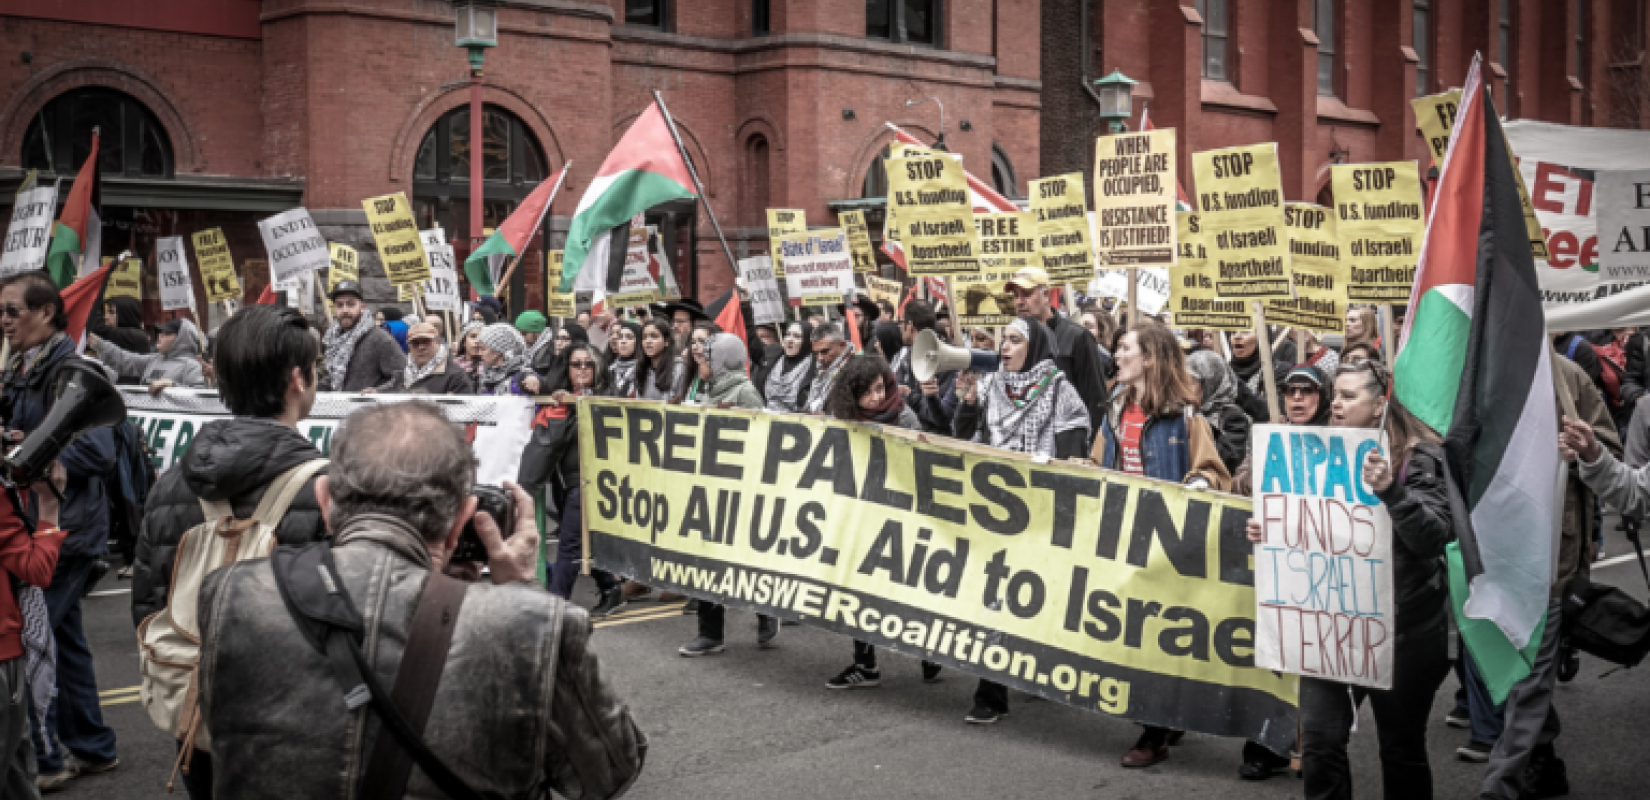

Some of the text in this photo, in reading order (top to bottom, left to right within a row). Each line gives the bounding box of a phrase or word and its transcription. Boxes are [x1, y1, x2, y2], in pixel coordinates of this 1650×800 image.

[1114, 135, 1151, 156] WHEN
[906, 159, 943, 181] STOP
[1100, 152, 1169, 178] PEOPLE ARE
[1213, 152, 1253, 179] STOP
[1039, 178, 1067, 199] STOP
[1103, 174, 1164, 197] OCCUPIED,
[1352, 168, 1395, 192] STOP
[374, 197, 396, 215] STOP
[895, 188, 967, 207] U.S. funding
[1201, 187, 1279, 212] U.S. funding
[1101, 204, 1168, 227] RESISTANCE
[1285, 206, 1326, 231] STOP
[1339, 201, 1420, 221] U.S. funding
[271, 223, 294, 240] END
[910, 218, 966, 237] of Israeli
[1188, 213, 1202, 234] S
[781, 240, 804, 257] State
[805, 236, 813, 254] of
[981, 238, 1034, 254] ESTINE
[1099, 226, 1171, 250] IS JUSTIFIED!
[1216, 226, 1277, 250] of Israeli
[1351, 236, 1413, 257] of Israeli
[911, 241, 972, 260] Apartheid
[1183, 272, 1198, 288] of
[1219, 256, 1283, 281] Apartheid
[1292, 269, 1334, 291] sraeli
[590, 406, 748, 480] FREE
[1260, 431, 1384, 506] AIPAC
[1262, 493, 1376, 558] FUNDS
[595, 469, 1258, 668] Stop All U.S. Aid to Israe
[1263, 546, 1384, 617] ISRAELI
[650, 555, 1132, 716] www.ANSWERcoalition.org
[1258, 602, 1387, 682] TERROR
